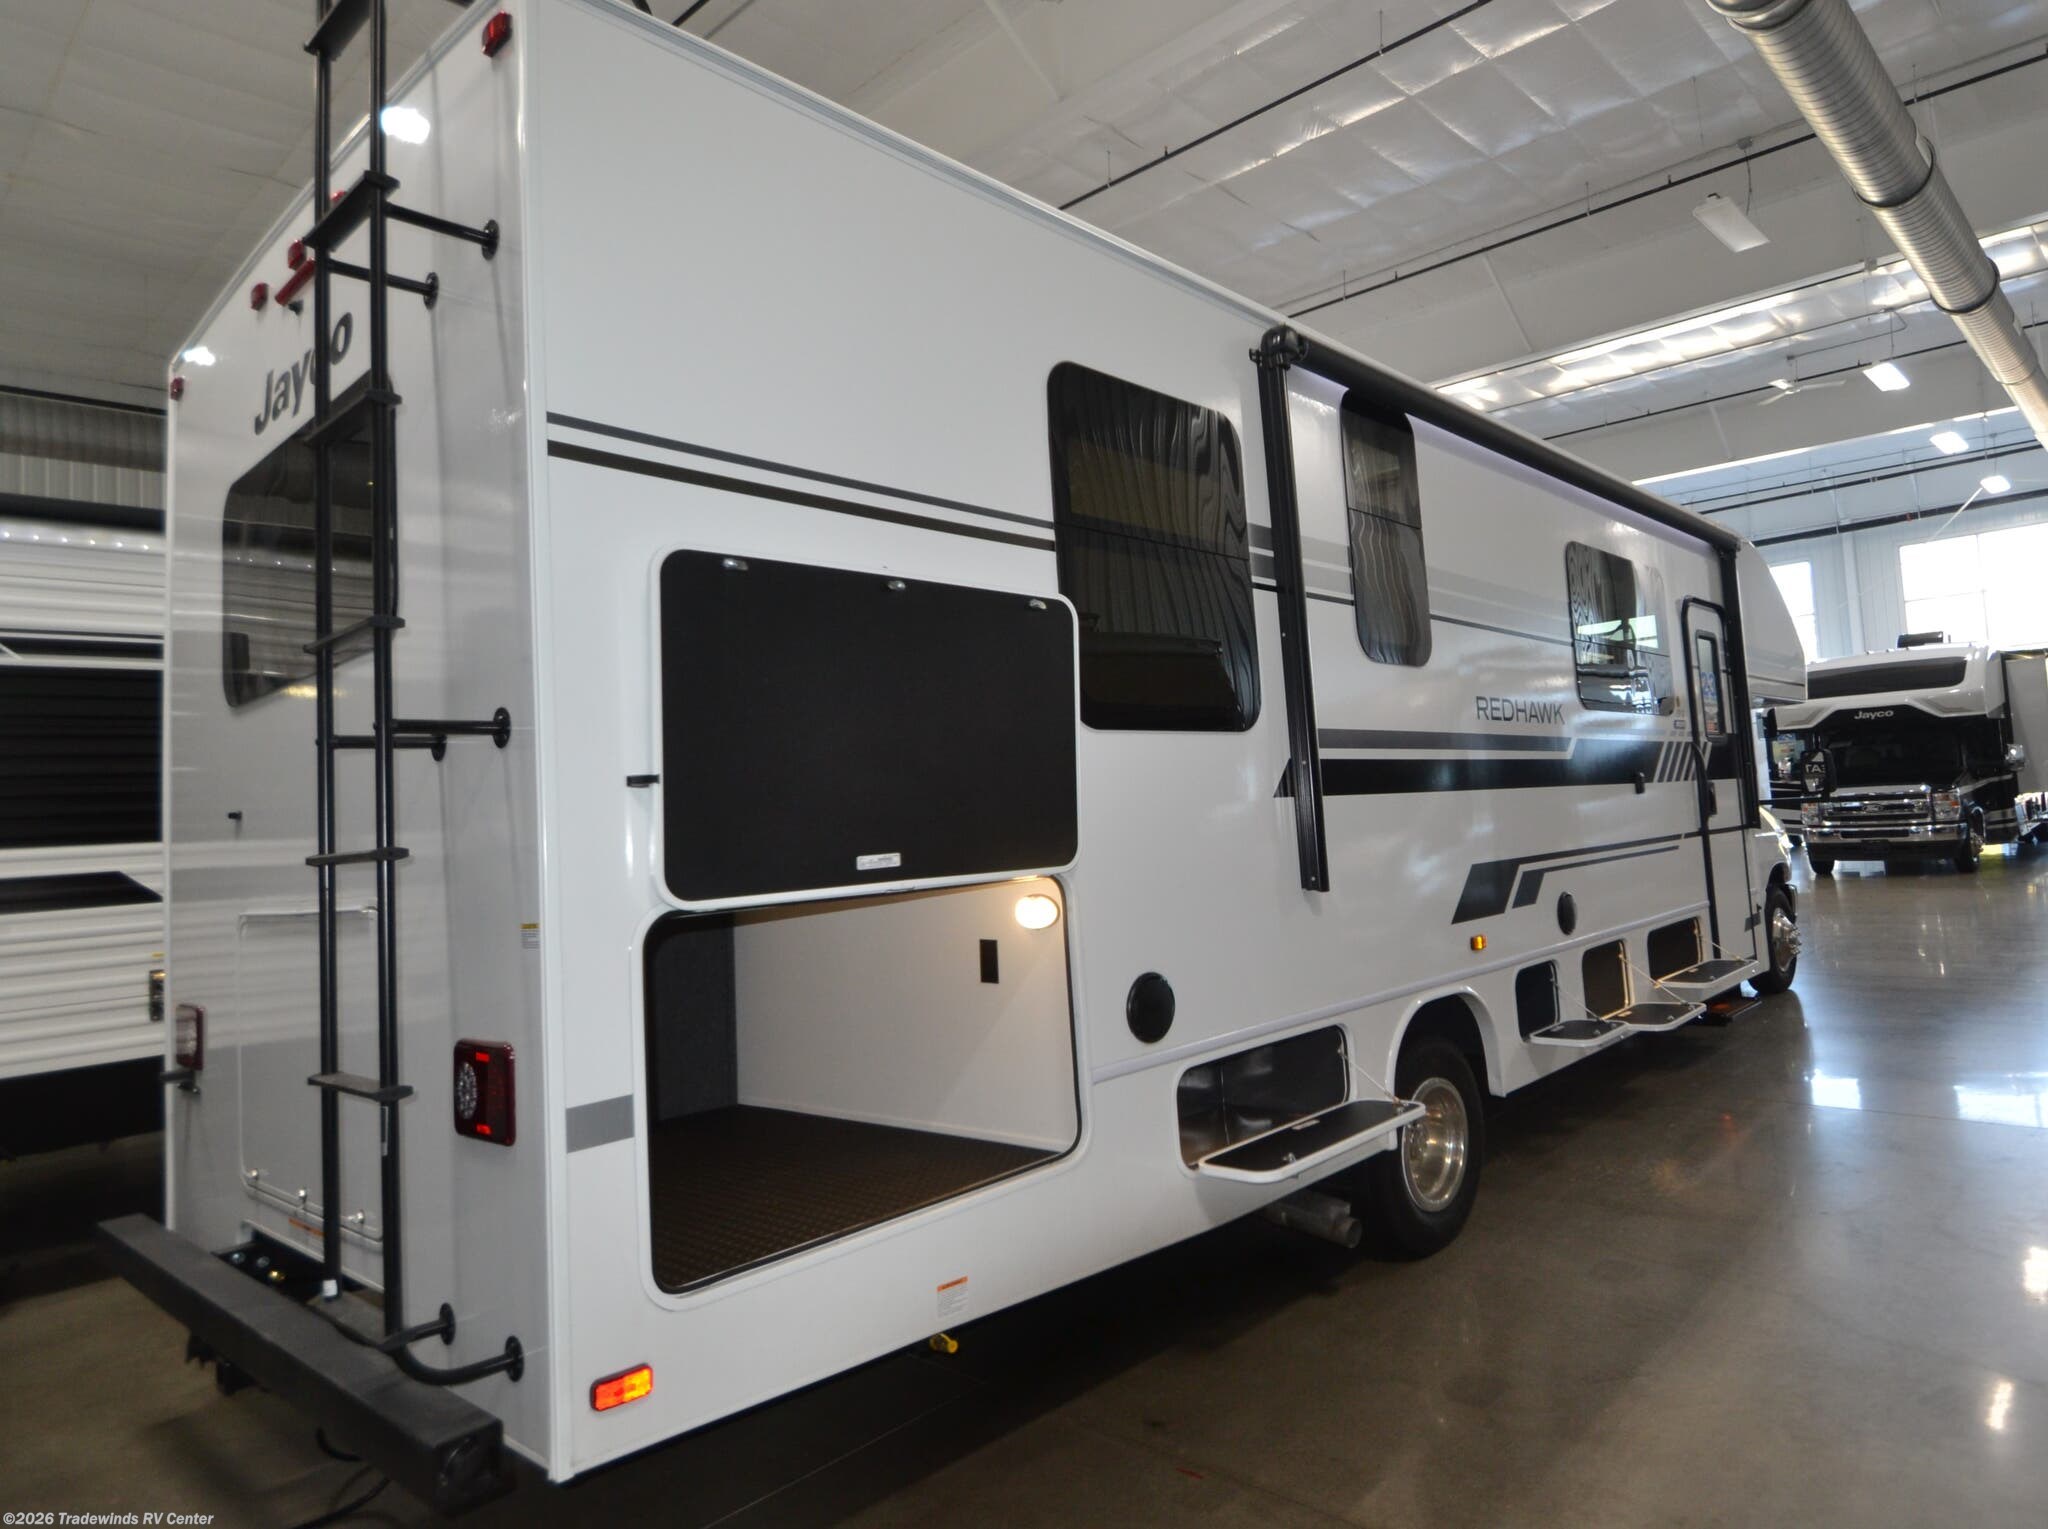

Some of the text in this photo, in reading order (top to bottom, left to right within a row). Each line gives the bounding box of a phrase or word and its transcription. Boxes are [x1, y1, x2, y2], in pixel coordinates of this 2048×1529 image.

[254, 312, 353, 436] Jayo
[1475, 695, 1565, 725] REDHAWK
[1854, 710, 1894, 720] Jayco
